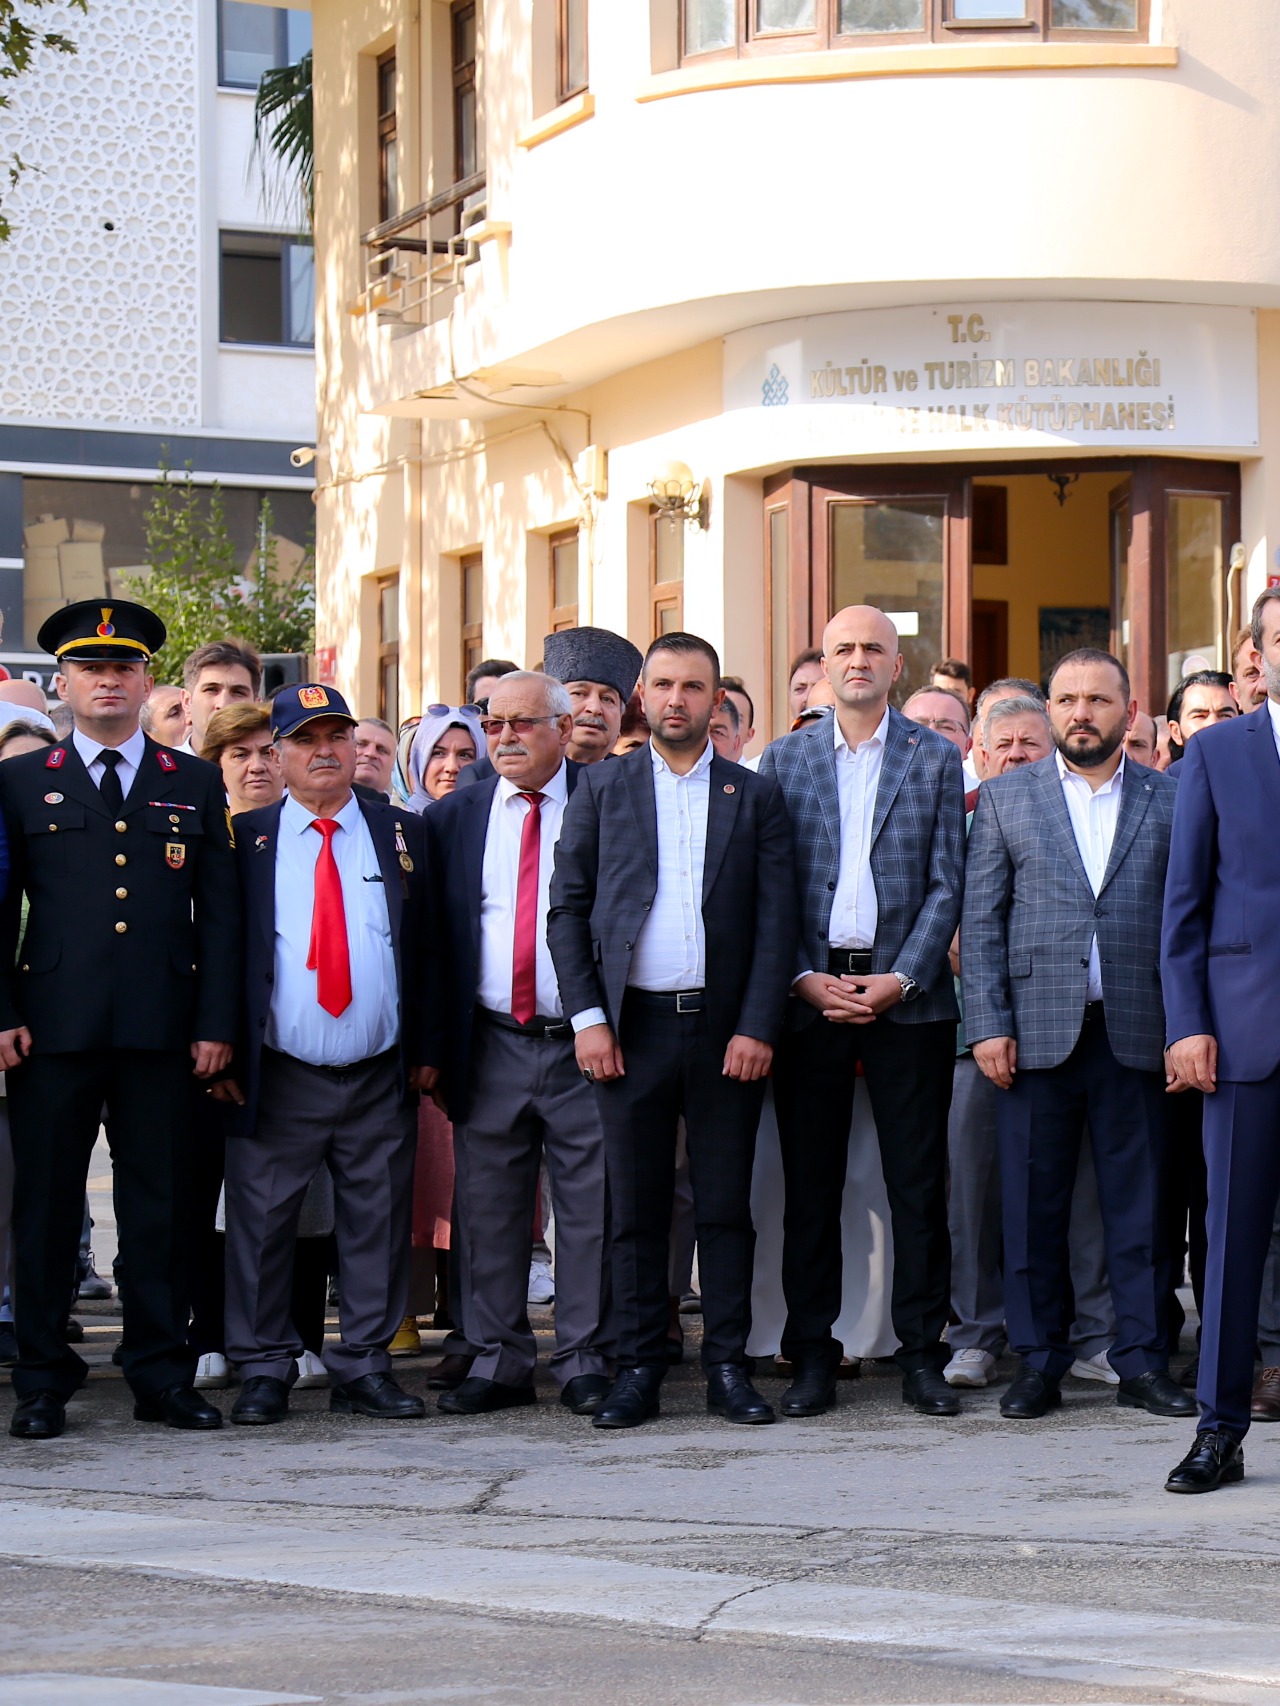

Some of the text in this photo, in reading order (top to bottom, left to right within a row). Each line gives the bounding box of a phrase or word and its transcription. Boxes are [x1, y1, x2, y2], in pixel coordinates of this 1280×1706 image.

[948, 313, 990, 343] T.C.
[811, 350, 1160, 398] KÜLTÜR ve TURİZM BAKANLIĞI
[997, 394, 1175, 430] KÜTÜPHANESİ
